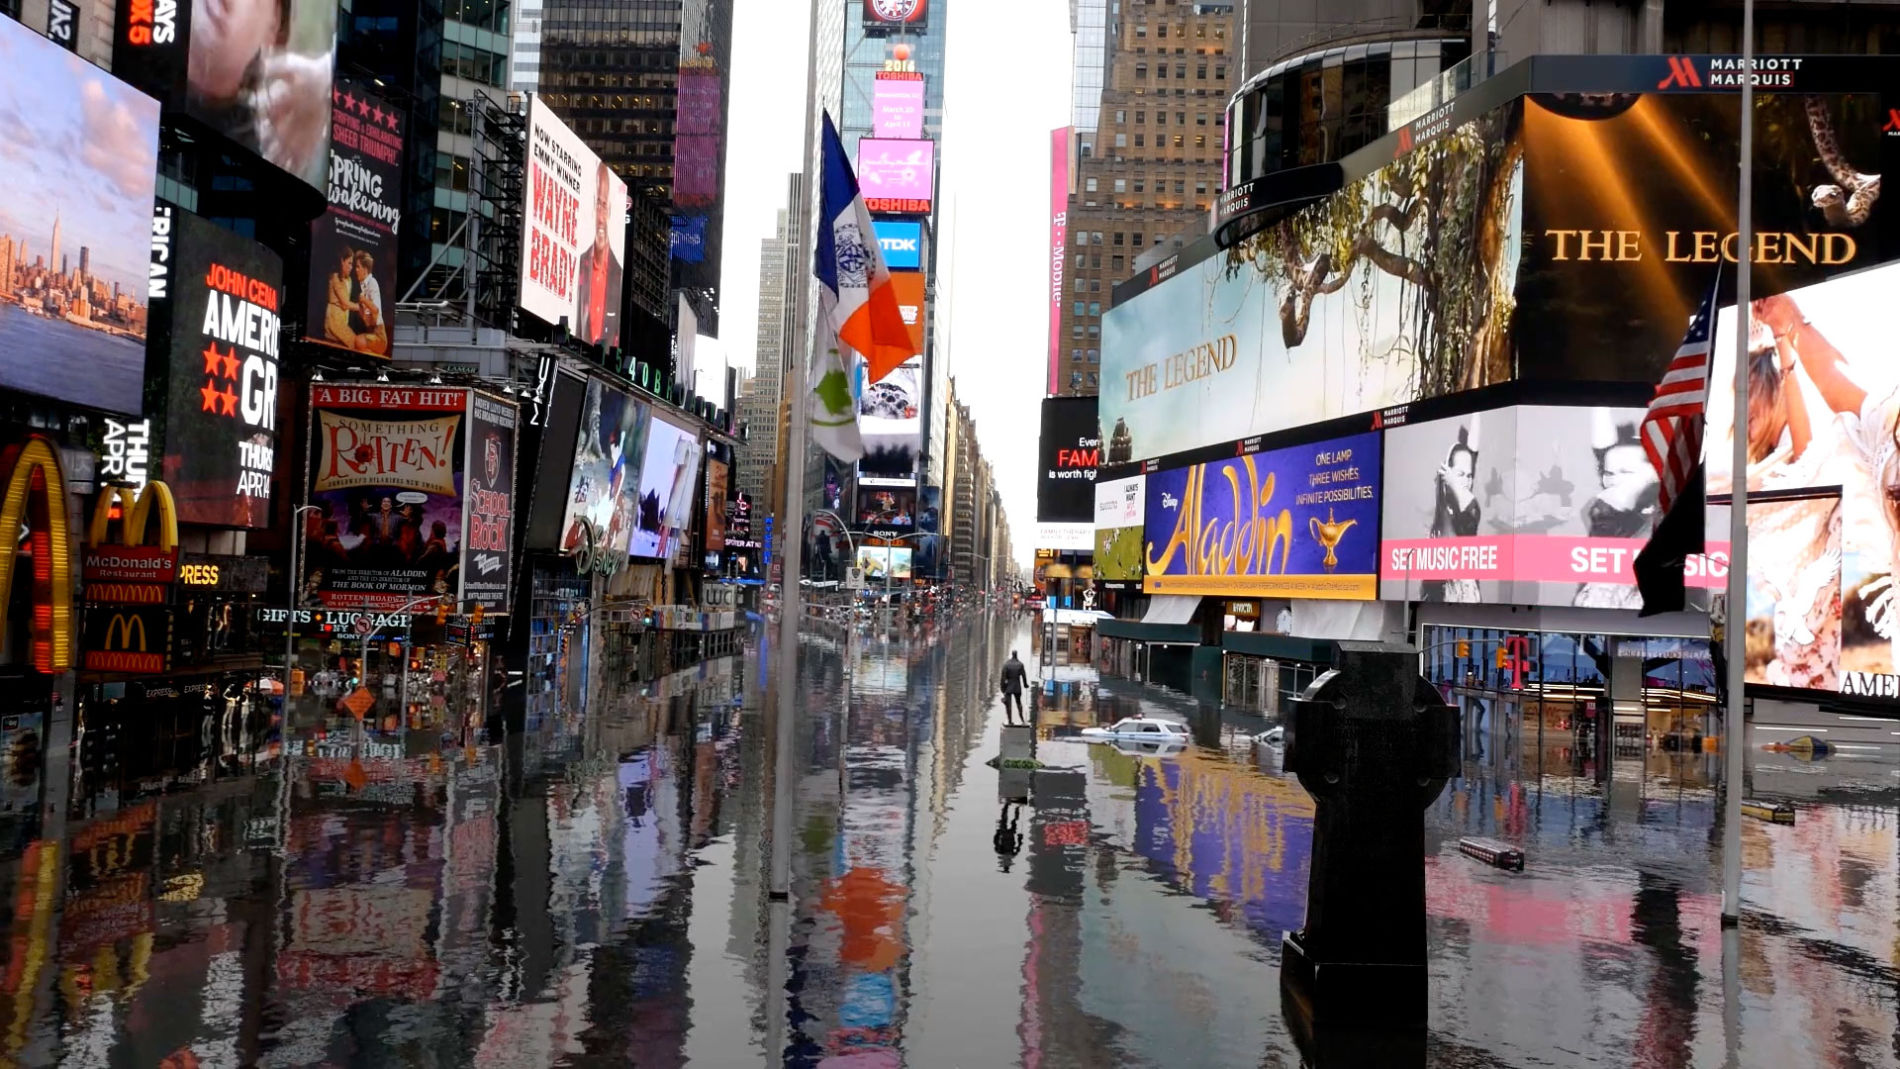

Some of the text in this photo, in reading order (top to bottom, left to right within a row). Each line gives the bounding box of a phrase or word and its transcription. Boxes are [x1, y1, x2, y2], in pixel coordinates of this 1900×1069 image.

[1710, 58, 1803, 70] MARRIOTT
[876, 72, 922, 80] TOSHIBA
[1710, 73, 1792, 85] MARQUIS
[1415, 102, 1455, 130] MARRIOTT
[333, 123, 359, 149] SHEER
[1415, 118, 1450, 144] MARQUIS
[535, 123, 582, 177] NOW STARRING
[534, 146, 581, 195] EMMY WINNER
[1219, 182, 1254, 205] MARRIOTT
[533, 162, 579, 248] WAYNE
[863, 198, 930, 212] TOSHIBA
[1219, 198, 1249, 216] MARQUIS
[881, 238, 916, 251] TDK
[1545, 229, 1857, 265] THE LEGEND
[1159, 254, 1178, 268] MARRIOTT
[205, 263, 278, 312] JOHN CENA
[1126, 333, 1238, 402] THE LEGEND
[380, 390, 414, 405] FAT
[1384, 405, 1409, 417] MARRIOTT
[1384, 414, 1406, 426] MARQUIS
[338, 419, 440, 435] SOMETHING
[101, 418, 126, 475] APR
[1244, 436, 1262, 445] MARRIOTT
[1058, 449, 1098, 467] FAM
[1315, 451, 1331, 466] ONE
[1049, 469, 1056, 479] is
[1058, 469, 1082, 479] worth
[1308, 471, 1331, 487] THREE
[236, 471, 261, 497] APR
[470, 479, 511, 518] SCHOOL
[1161, 492, 1179, 511] Disney
[1296, 492, 1323, 506] INFINITE
[1146, 456, 1293, 576] Aladdin
[469, 514, 509, 551] ROCK
[86, 555, 172, 569] McDonald's
[1391, 545, 1498, 570] SET MUSIC FREE
[1570, 547, 1626, 574] SET
[100, 569, 157, 578] Restaurant
[390, 569, 428, 577] ALADDIN
[388, 583, 427, 591] MORMON
[333, 624, 348, 632] NY
[1842, 672, 1900, 697] AME
